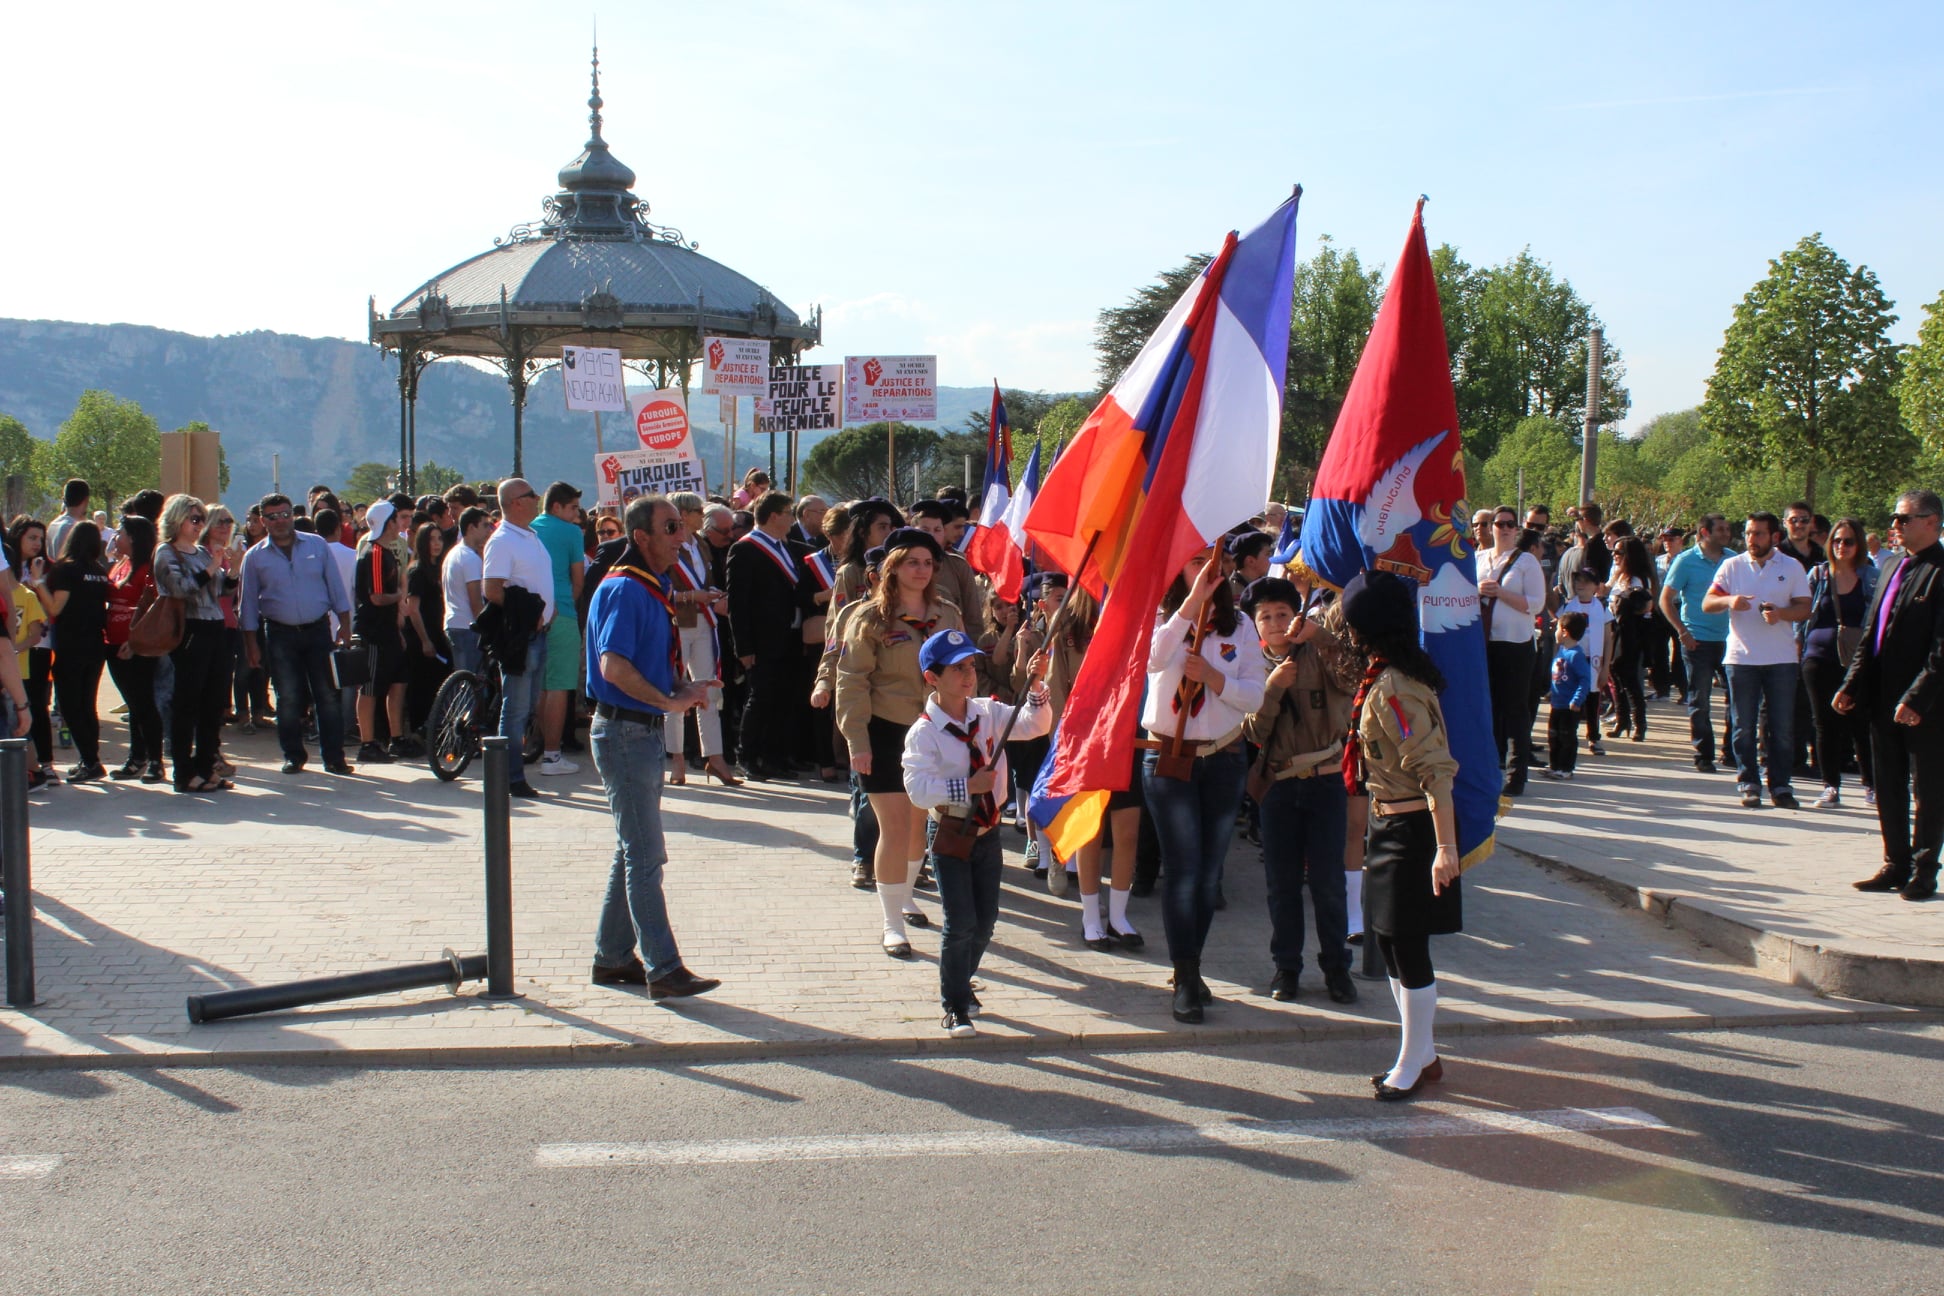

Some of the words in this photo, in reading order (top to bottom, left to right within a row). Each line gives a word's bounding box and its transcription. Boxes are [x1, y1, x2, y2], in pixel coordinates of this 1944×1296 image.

[578, 352, 614, 377] 1915
[721, 363, 749, 373] JUSTICE
[751, 364, 759, 374] ET
[714, 374, 764, 385] REPARATIONS
[769, 366, 822, 382] USTICE
[769, 382, 809, 399] POUR
[818, 382, 836, 397] LE
[880, 378, 912, 387] JUSTICE
[915, 378, 925, 387] ET
[567, 380, 597, 402] NEVER
[872, 388, 932, 397] REPARATIONS
[641, 406, 678, 421] TURQUIE
[773, 397, 831, 415] PEUPLE
[758, 413, 835, 431] ARMENIEN
[648, 431, 682, 445] EUROPE
[620, 461, 691, 486] TURQUIE
